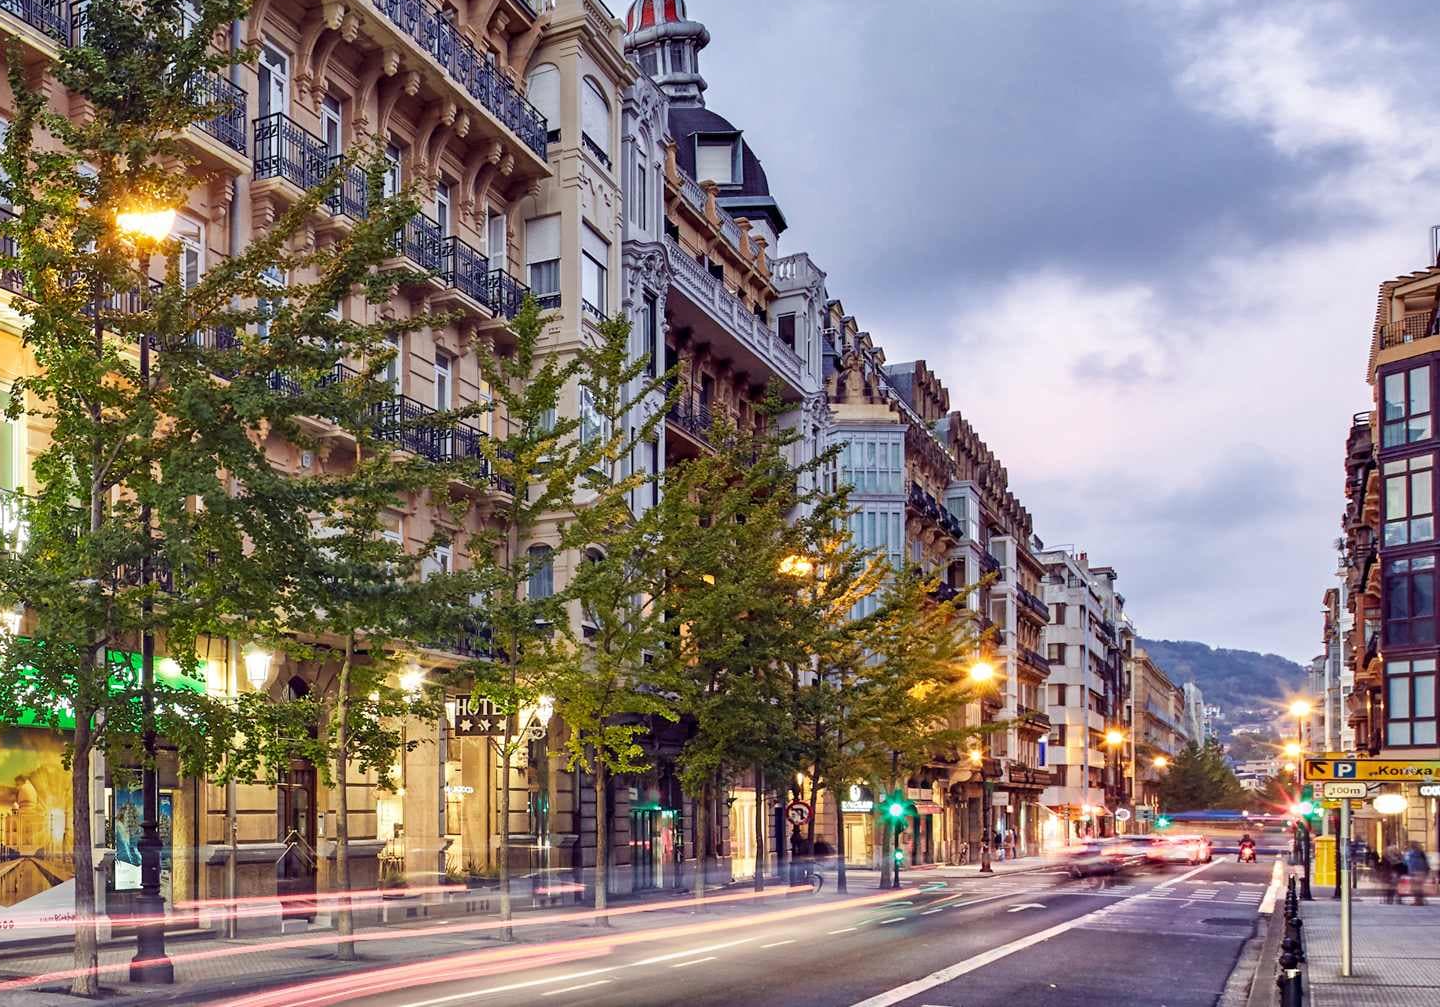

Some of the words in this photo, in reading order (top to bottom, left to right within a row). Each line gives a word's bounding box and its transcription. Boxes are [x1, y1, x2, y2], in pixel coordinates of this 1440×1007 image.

[455, 698, 508, 716] HOTE
[1337, 763, 1353, 777] P
[1378, 766, 1433, 776] Koxa
